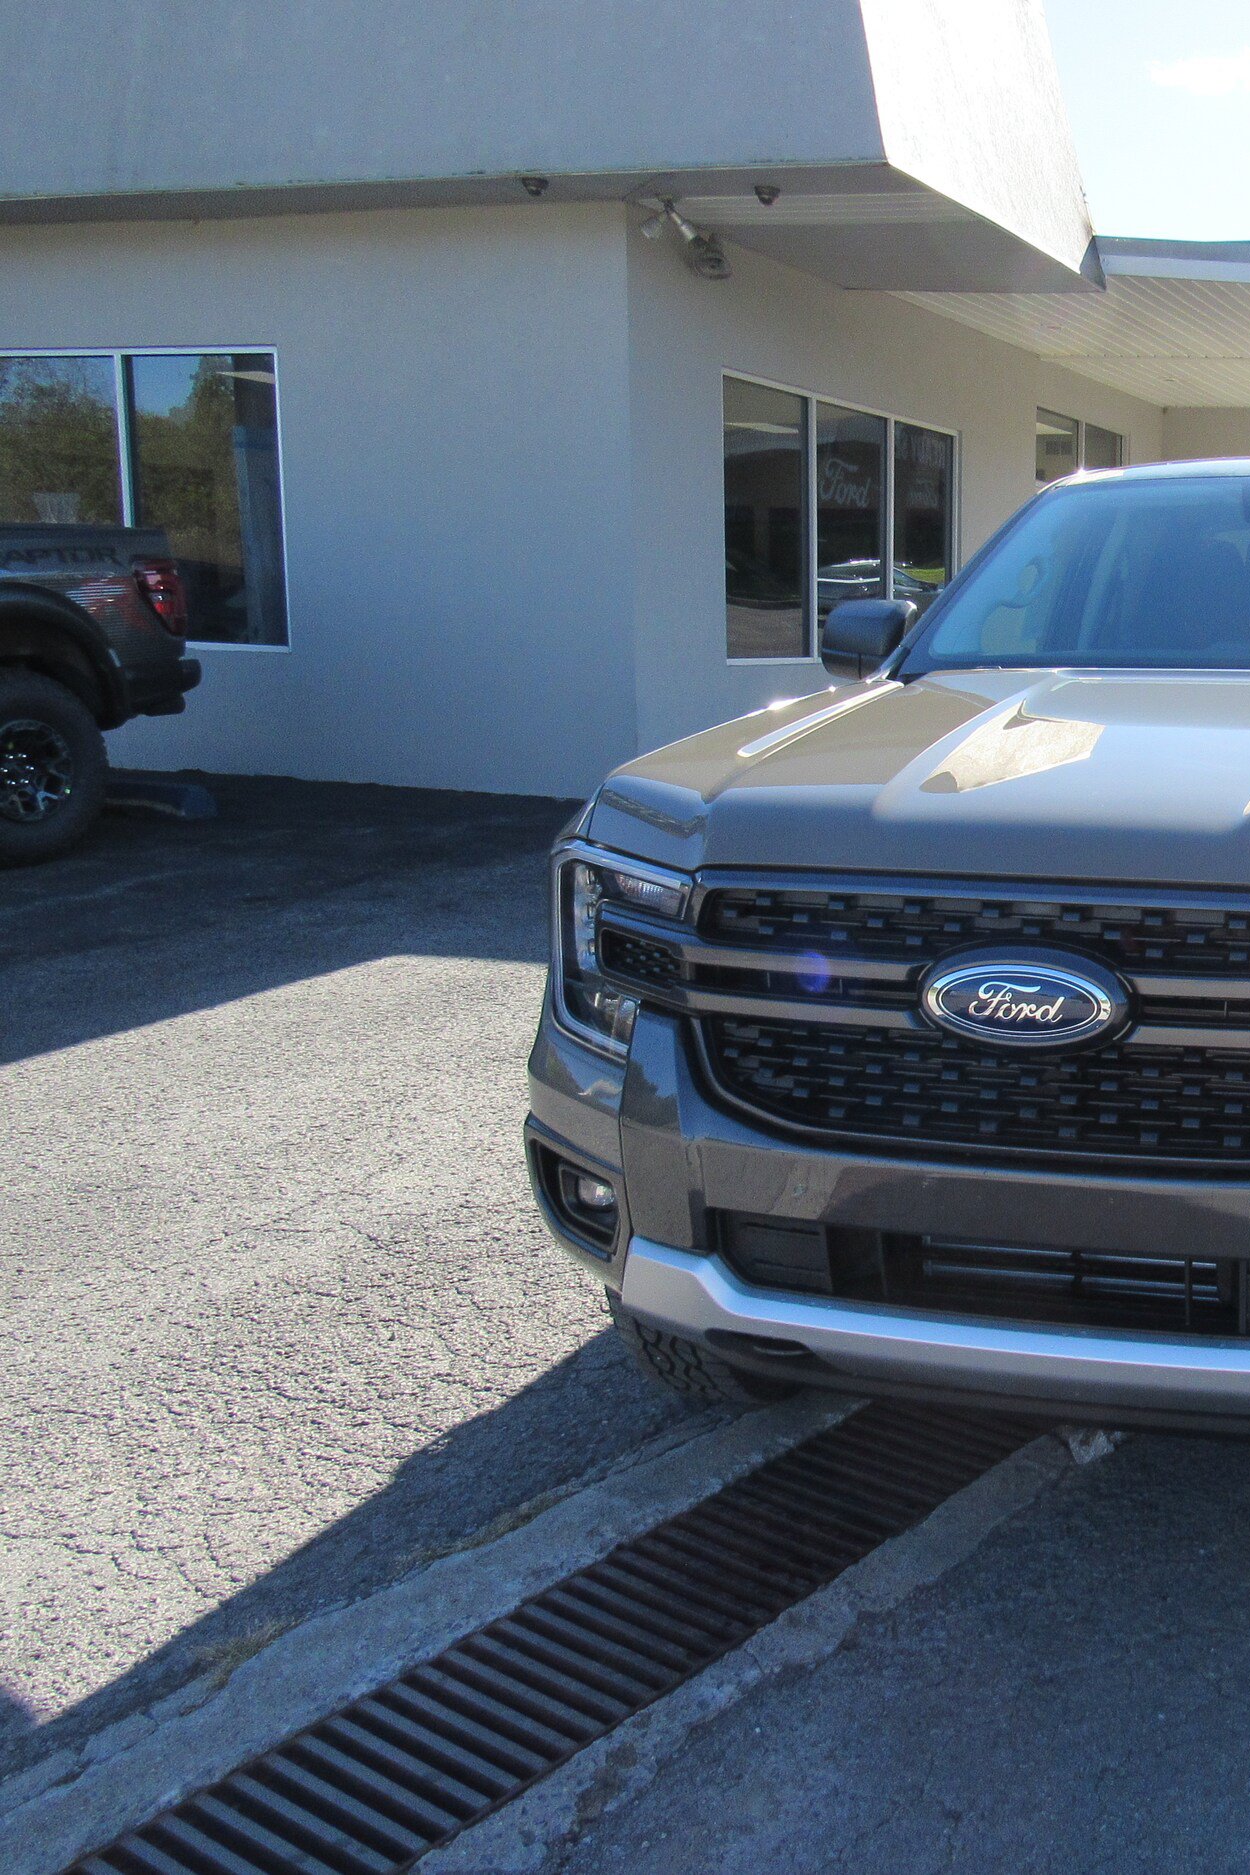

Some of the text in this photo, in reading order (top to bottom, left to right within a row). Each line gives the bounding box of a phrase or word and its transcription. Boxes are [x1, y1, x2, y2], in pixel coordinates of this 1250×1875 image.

[819, 458, 871, 508] Ford
[0, 546, 124, 567] APTOR
[968, 981, 1066, 1023] Ford
